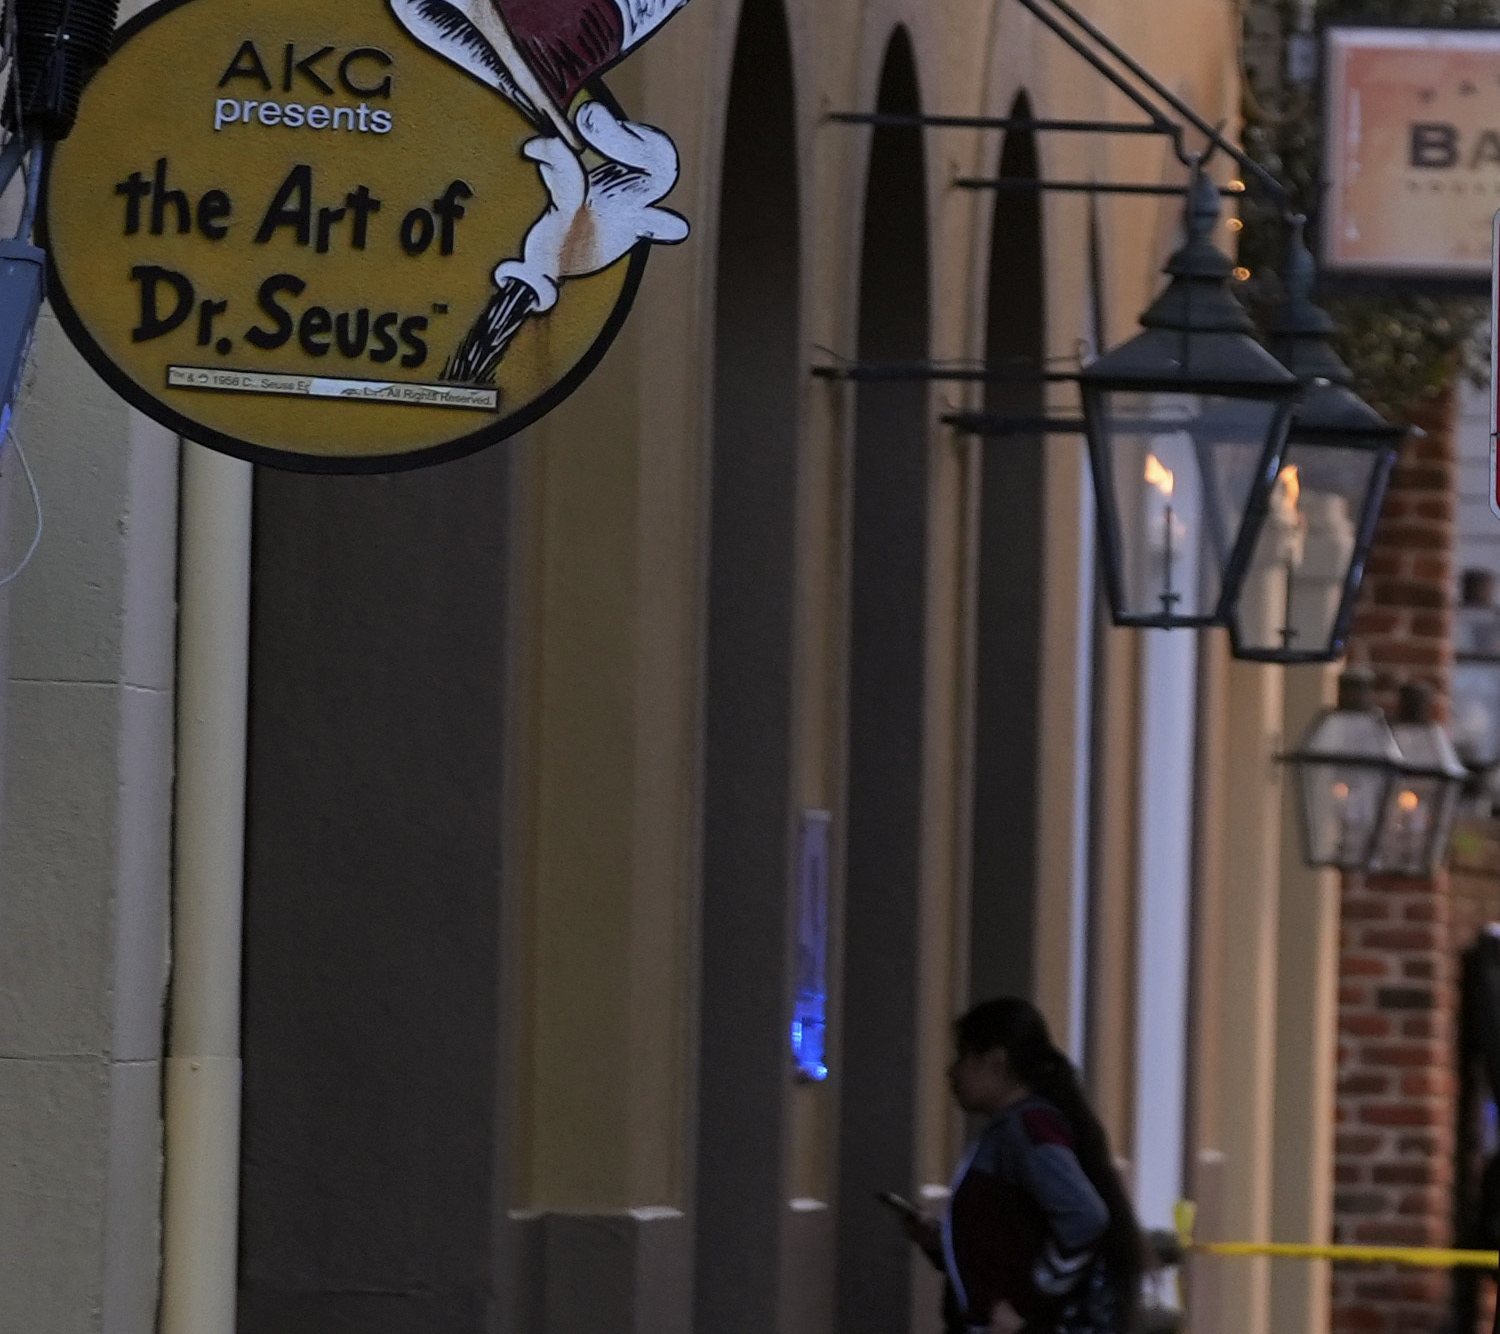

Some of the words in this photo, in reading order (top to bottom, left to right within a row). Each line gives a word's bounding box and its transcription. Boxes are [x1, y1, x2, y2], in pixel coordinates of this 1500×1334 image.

[217, 39, 393, 99] AKG
[213, 97, 393, 134] presents
[115, 157, 232, 241] the
[254, 164, 382, 254] Art
[400, 178, 474, 256] of
[131, 265, 233, 356] Dr.
[403, 389, 437, 403] Rights
